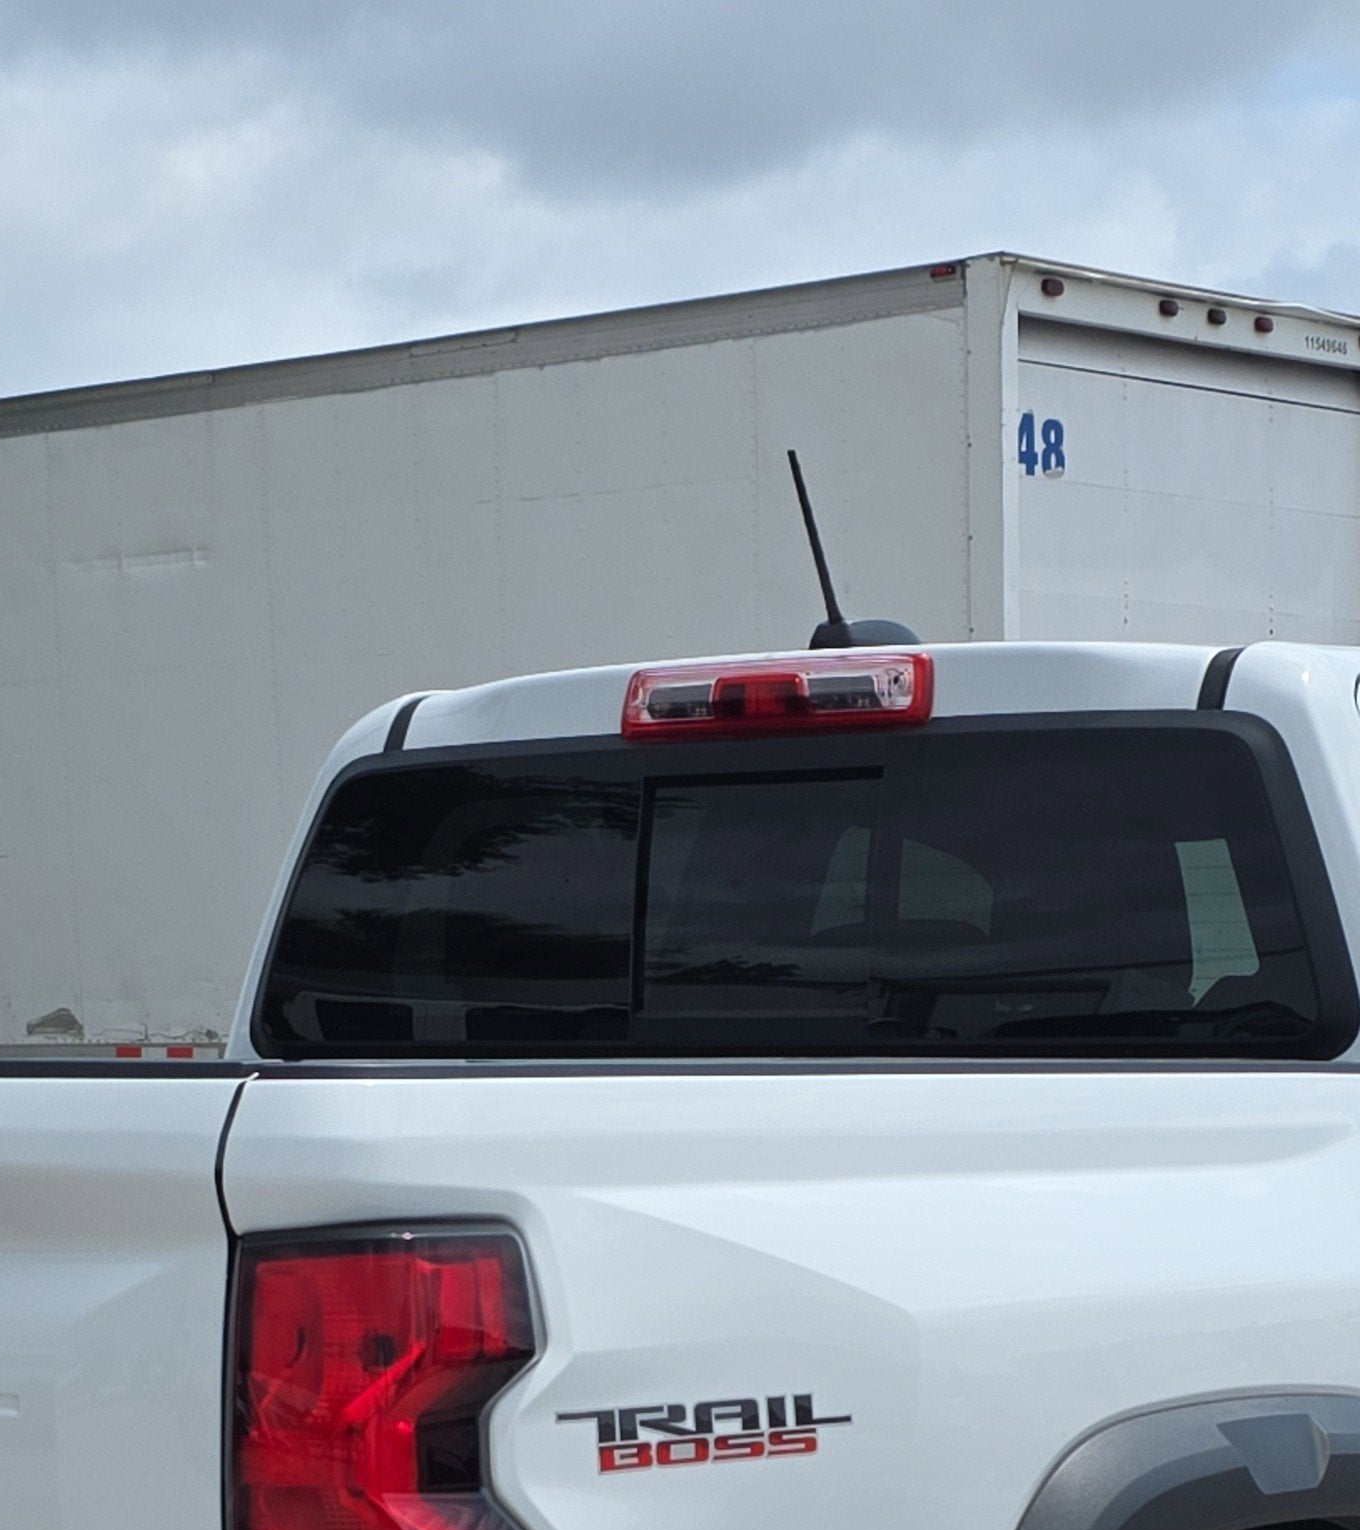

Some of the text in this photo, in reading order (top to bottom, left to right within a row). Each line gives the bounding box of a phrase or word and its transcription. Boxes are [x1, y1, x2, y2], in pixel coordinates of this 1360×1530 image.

[1018, 409, 1066, 478] 48
[555, 1393, 852, 1444] TRAIL
[597, 1427, 818, 1475] BOSS
